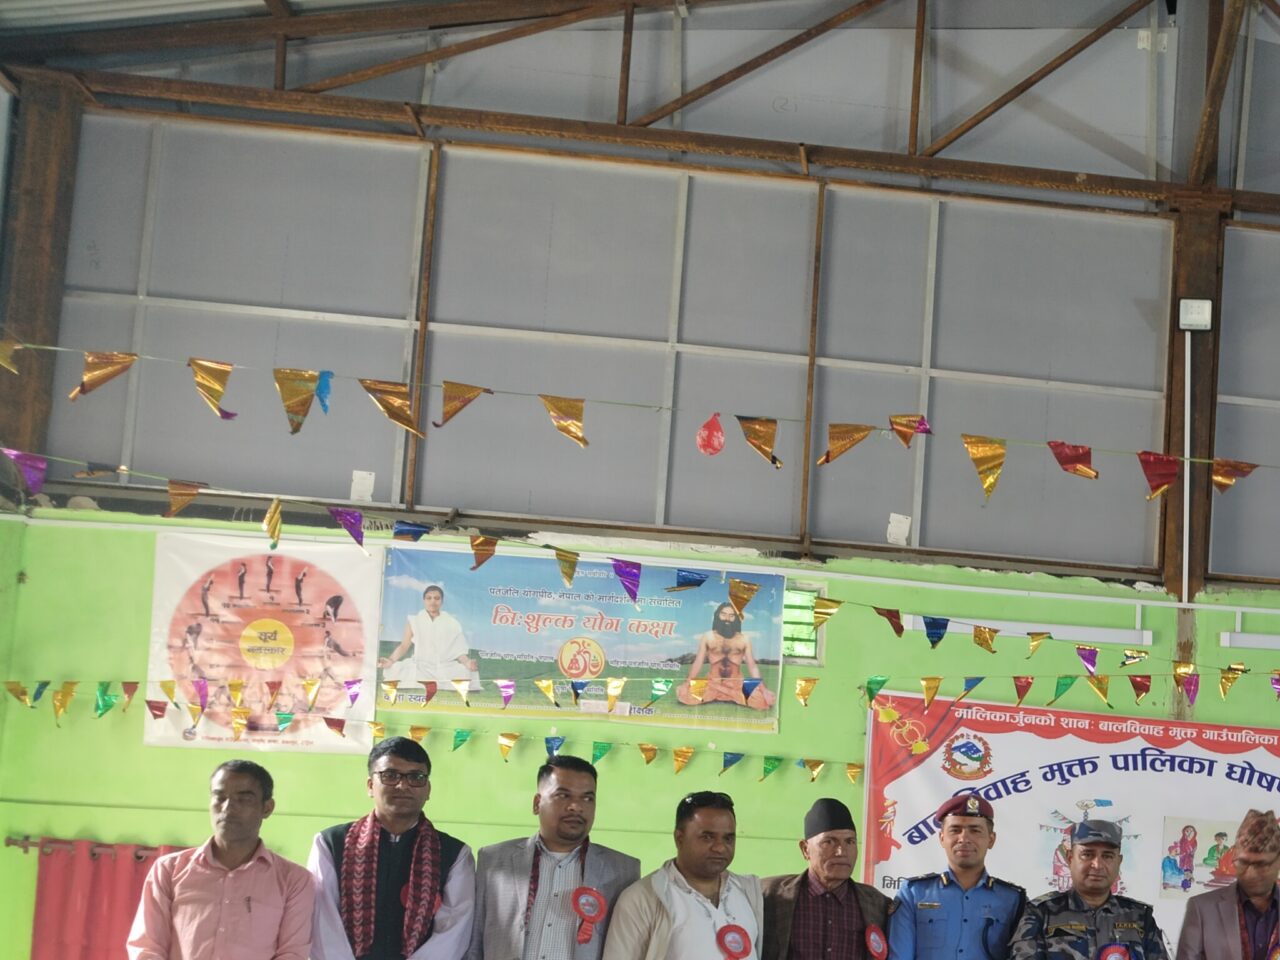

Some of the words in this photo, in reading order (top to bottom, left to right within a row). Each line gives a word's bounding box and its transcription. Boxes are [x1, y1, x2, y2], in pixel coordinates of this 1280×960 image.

[257, 629, 278, 643] सूर्य
[492, 604, 574, 633] निःशुल्क
[583, 611, 622, 632] योग
[629, 620, 675, 639] कक्षा
[953, 706, 1056, 729] मालिकार्जुनको
[1099, 720, 1165, 737] बालविवाह
[1168, 725, 1198, 740] मुक्त
[1202, 726, 1278, 746] गाउँपालिका
[1038, 754, 1101, 787] मुक्त
[1109, 746, 1219, 777] पालिका
[882, 875, 905, 890] मि
